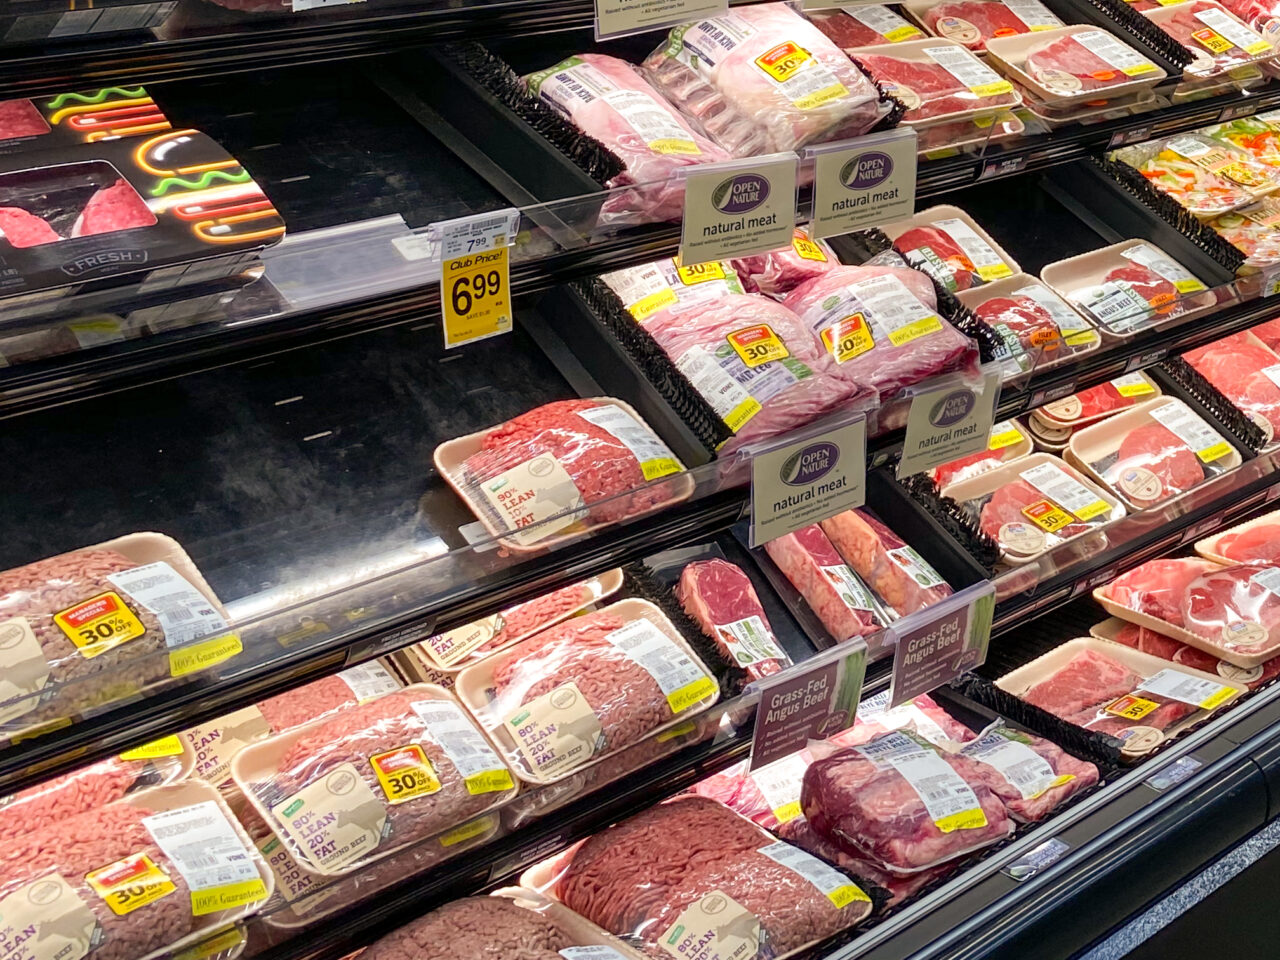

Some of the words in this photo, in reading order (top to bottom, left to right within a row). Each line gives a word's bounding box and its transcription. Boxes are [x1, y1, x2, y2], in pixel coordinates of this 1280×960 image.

[622, 3, 640, 12] without
[858, 168, 884, 181] NATURE
[859, 159, 885, 171] OPEN
[733, 181, 760, 194] OPEN
[732, 192, 759, 205] NATURE
[832, 193, 870, 212] natural
[872, 188, 898, 202] meat
[703, 218, 745, 236] natural
[748, 213, 776, 228] meat
[467, 238, 486, 252] 799
[75, 251, 133, 271] FRESH
[450, 260, 473, 271] Club
[474, 251, 502, 266] Price!
[452, 270, 500, 316] 699
[1119, 298, 1133, 310] BEEF
[744, 342, 775, 360] 30%
[946, 397, 968, 409] OPEN
[918, 432, 952, 450] natural
[953, 423, 977, 437] meat
[803, 448, 830, 465] OPEN
[801, 459, 829, 476] NATURE
[497, 488, 517, 503] 90%
[503, 490, 536, 512] LEAN
[773, 487, 815, 513] natural
[818, 476, 847, 496] meat
[508, 504, 527, 519] 10%
[515, 513, 535, 529] FAT
[79, 617, 124, 645] 30%
[115, 621, 133, 634] OFF
[908, 617, 958, 652] Grass-Fed
[435, 637, 455, 656] FAT
[441, 641, 467, 660] GROUND
[467, 630, 481, 643] BEEF
[903, 645, 935, 666] Angus
[936, 630, 960, 649] Beef
[174, 653, 195, 671] 100%
[196, 640, 241, 664] Guaranteed
[771, 674, 827, 709] Grass-Fed
[765, 700, 800, 725] Angus
[802, 688, 829, 710] Beef
[518, 721, 538, 738] 80%
[523, 724, 557, 747] LEAN
[193, 729, 220, 752] EAN
[530, 739, 550, 757] 20%
[196, 756, 218, 776] FAT
[535, 749, 556, 766] FAT
[539, 753, 567, 772] GROUND
[567, 744, 583, 759] BEEF
[388, 771, 425, 795] 30%
[417, 776, 432, 786] OFF
[292, 810, 316, 831] 80%
[300, 812, 337, 839] LEAN
[308, 829, 331, 851] 20%
[314, 840, 337, 860] FAT
[320, 842, 350, 866] GROUND
[350, 833, 367, 851] BEEF
[227, 854, 246, 862] VONS
[271, 851, 287, 866] 80
[283, 870, 299, 885] 20
[115, 885, 146, 904] 30
[195, 895, 218, 909] 100%
[219, 885, 265, 904] Guaranteed
[677, 932, 696, 953] 80%
[685, 930, 716, 959] LEAN
[733, 943, 748, 958] BEEF
